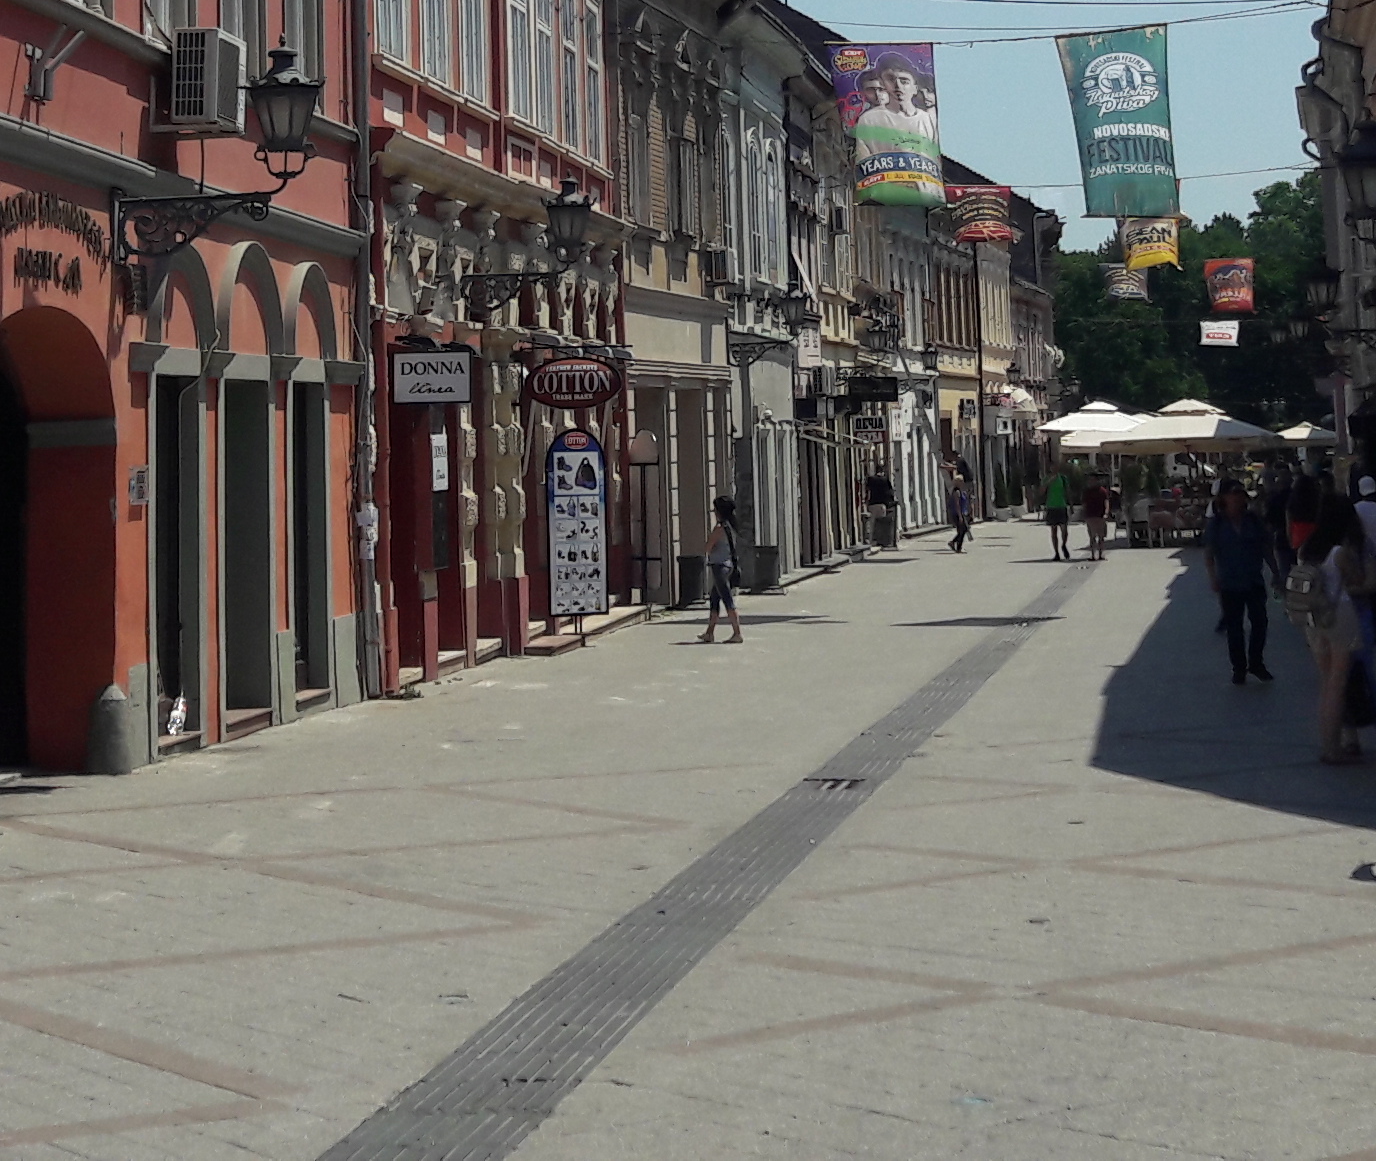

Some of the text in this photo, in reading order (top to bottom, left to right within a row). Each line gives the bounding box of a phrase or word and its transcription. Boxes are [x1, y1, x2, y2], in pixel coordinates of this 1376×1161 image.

[1086, 136, 1174, 168] FESTIVAL
[860, 155, 940, 178] YEARS & YEARS
[1089, 163, 1153, 179] ZANATSKOG
[1126, 226, 1172, 239] SEAN
[400, 361, 466, 376] DONNA
[532, 370, 612, 395] COTTON
